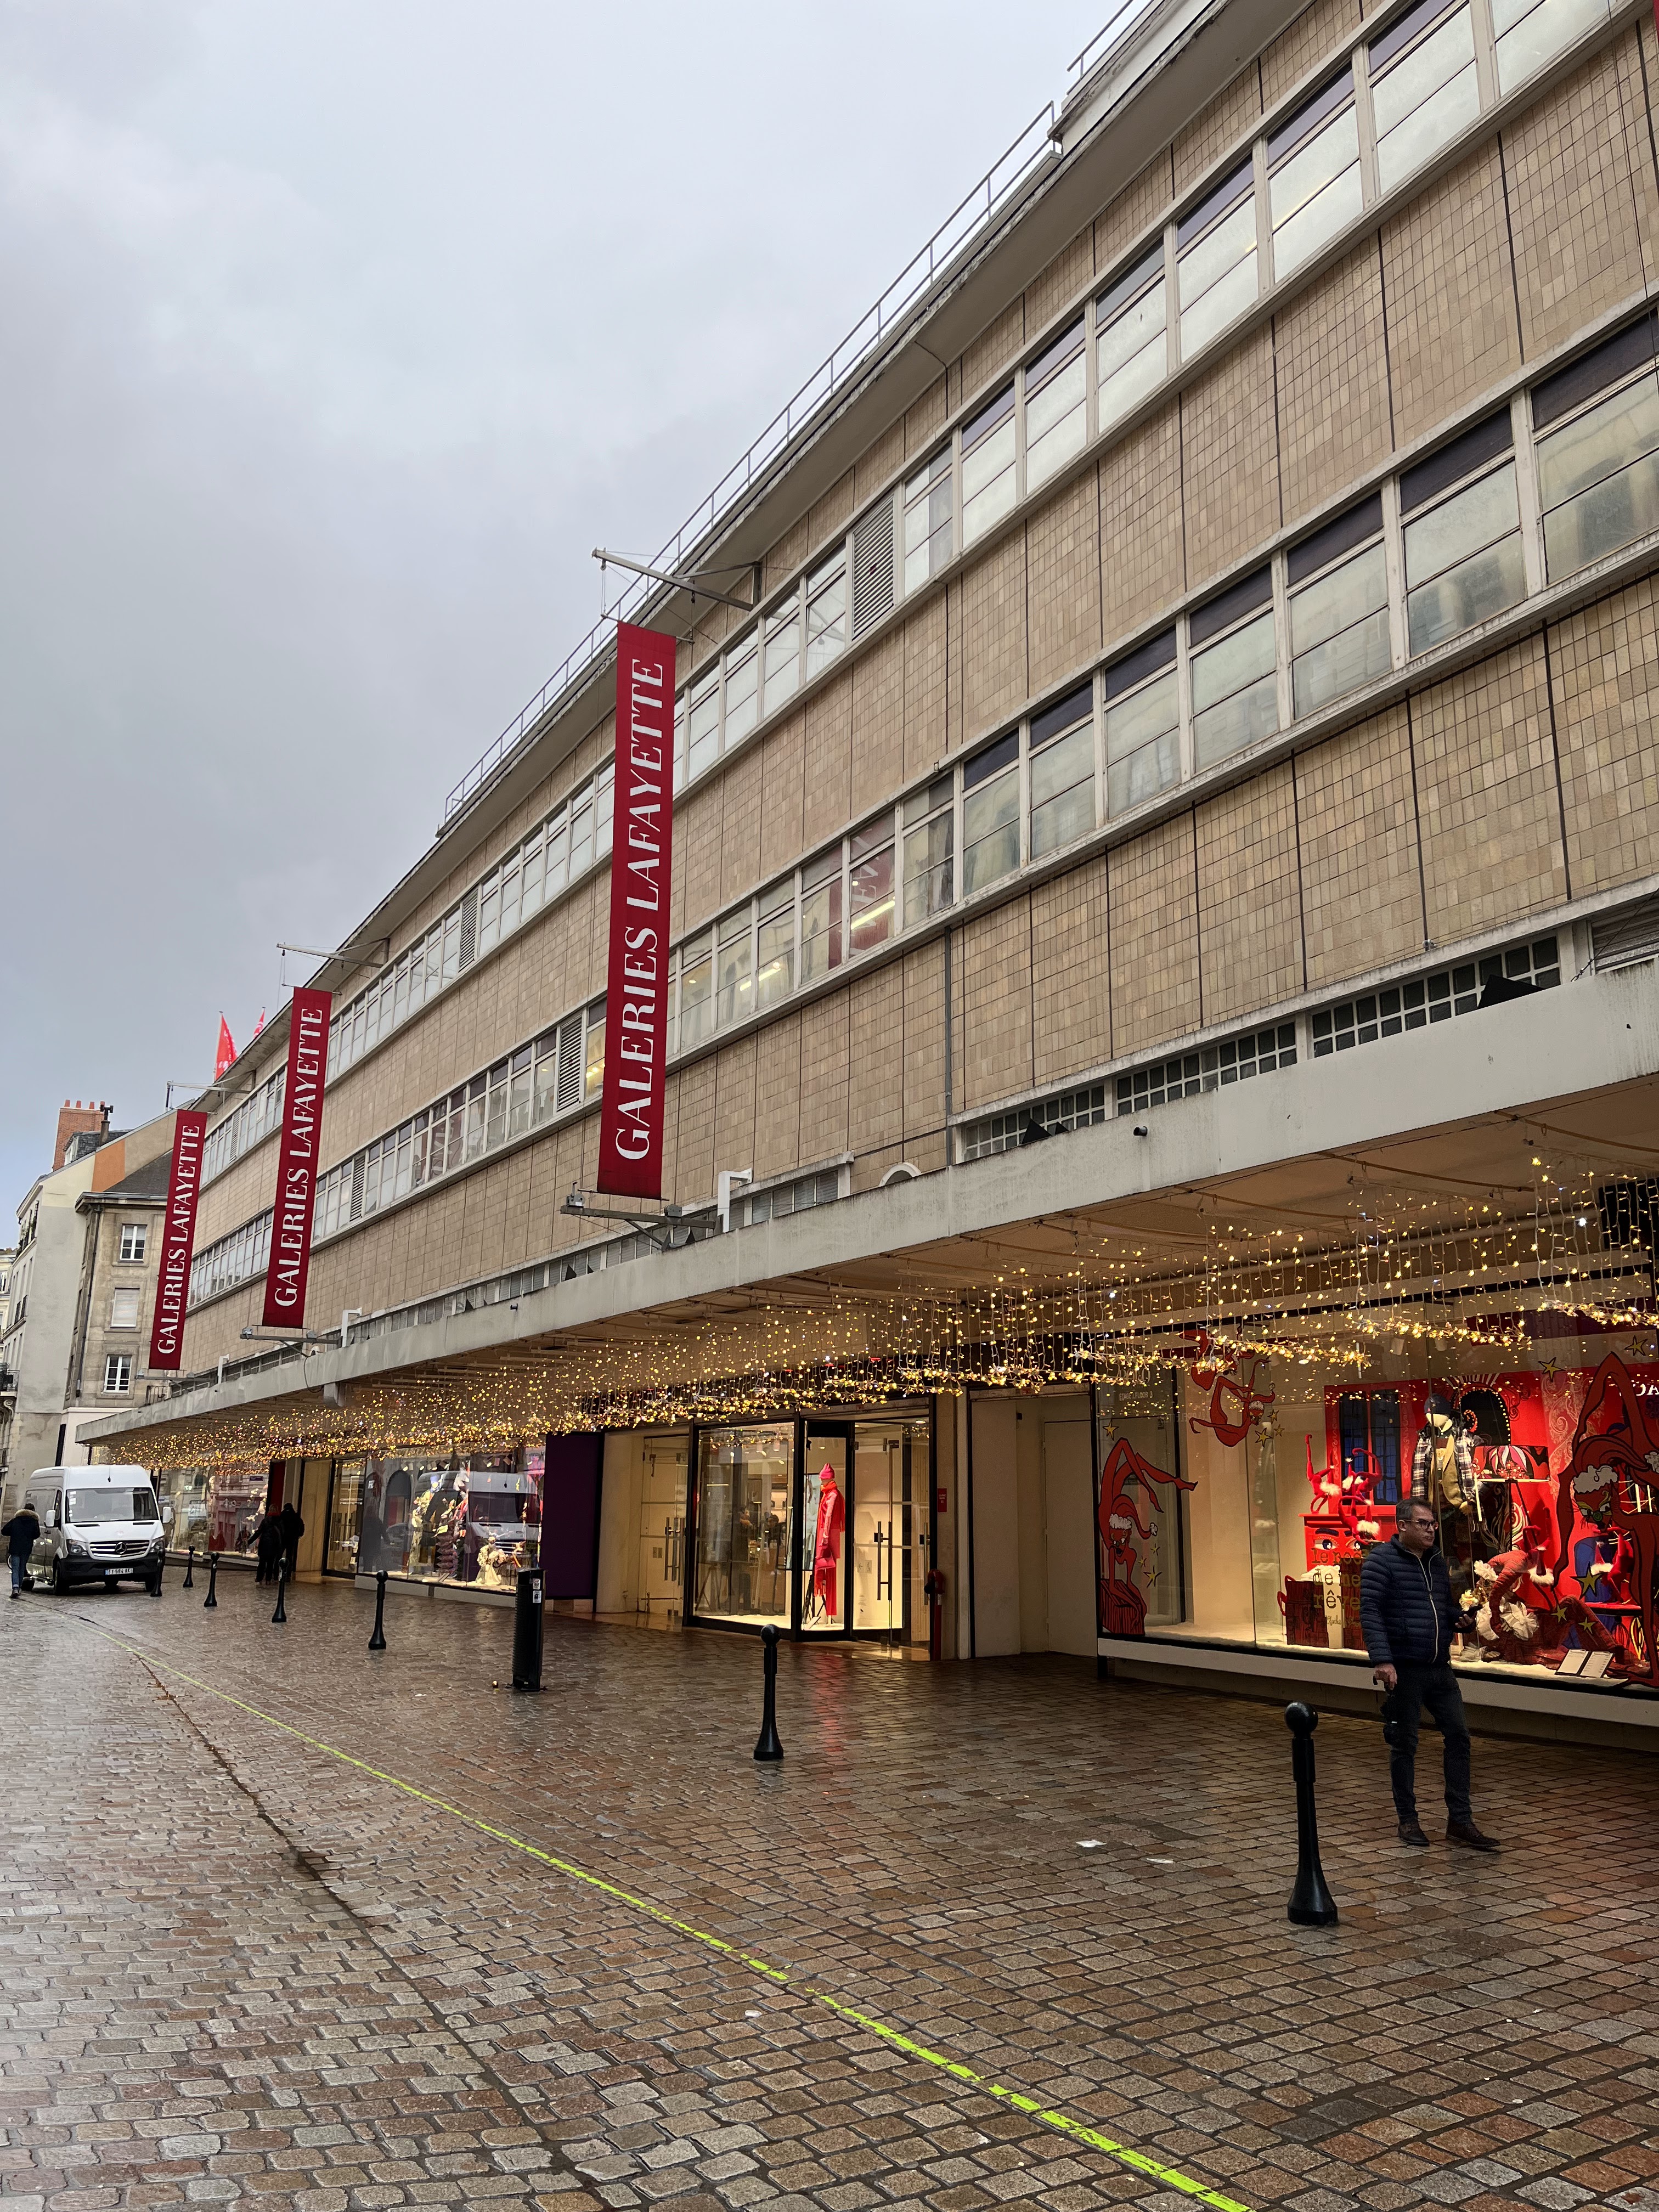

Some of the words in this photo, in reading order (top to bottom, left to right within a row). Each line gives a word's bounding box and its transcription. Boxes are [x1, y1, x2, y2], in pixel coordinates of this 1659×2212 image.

[627, 658, 663, 911] LAFAYETTE
[289, 1008, 323, 1158] LAFAYETTE
[615, 926, 658, 1160] GALERIES
[170, 1125, 200, 1242] LAFAYETTE
[274, 1168, 309, 1307] GALERIES
[157, 1249, 186, 1354] GALERIES
[1311, 1548, 1329, 1564] le
[1313, 1568, 1334, 1585] de
[1313, 1589, 1361, 1611] rêve
